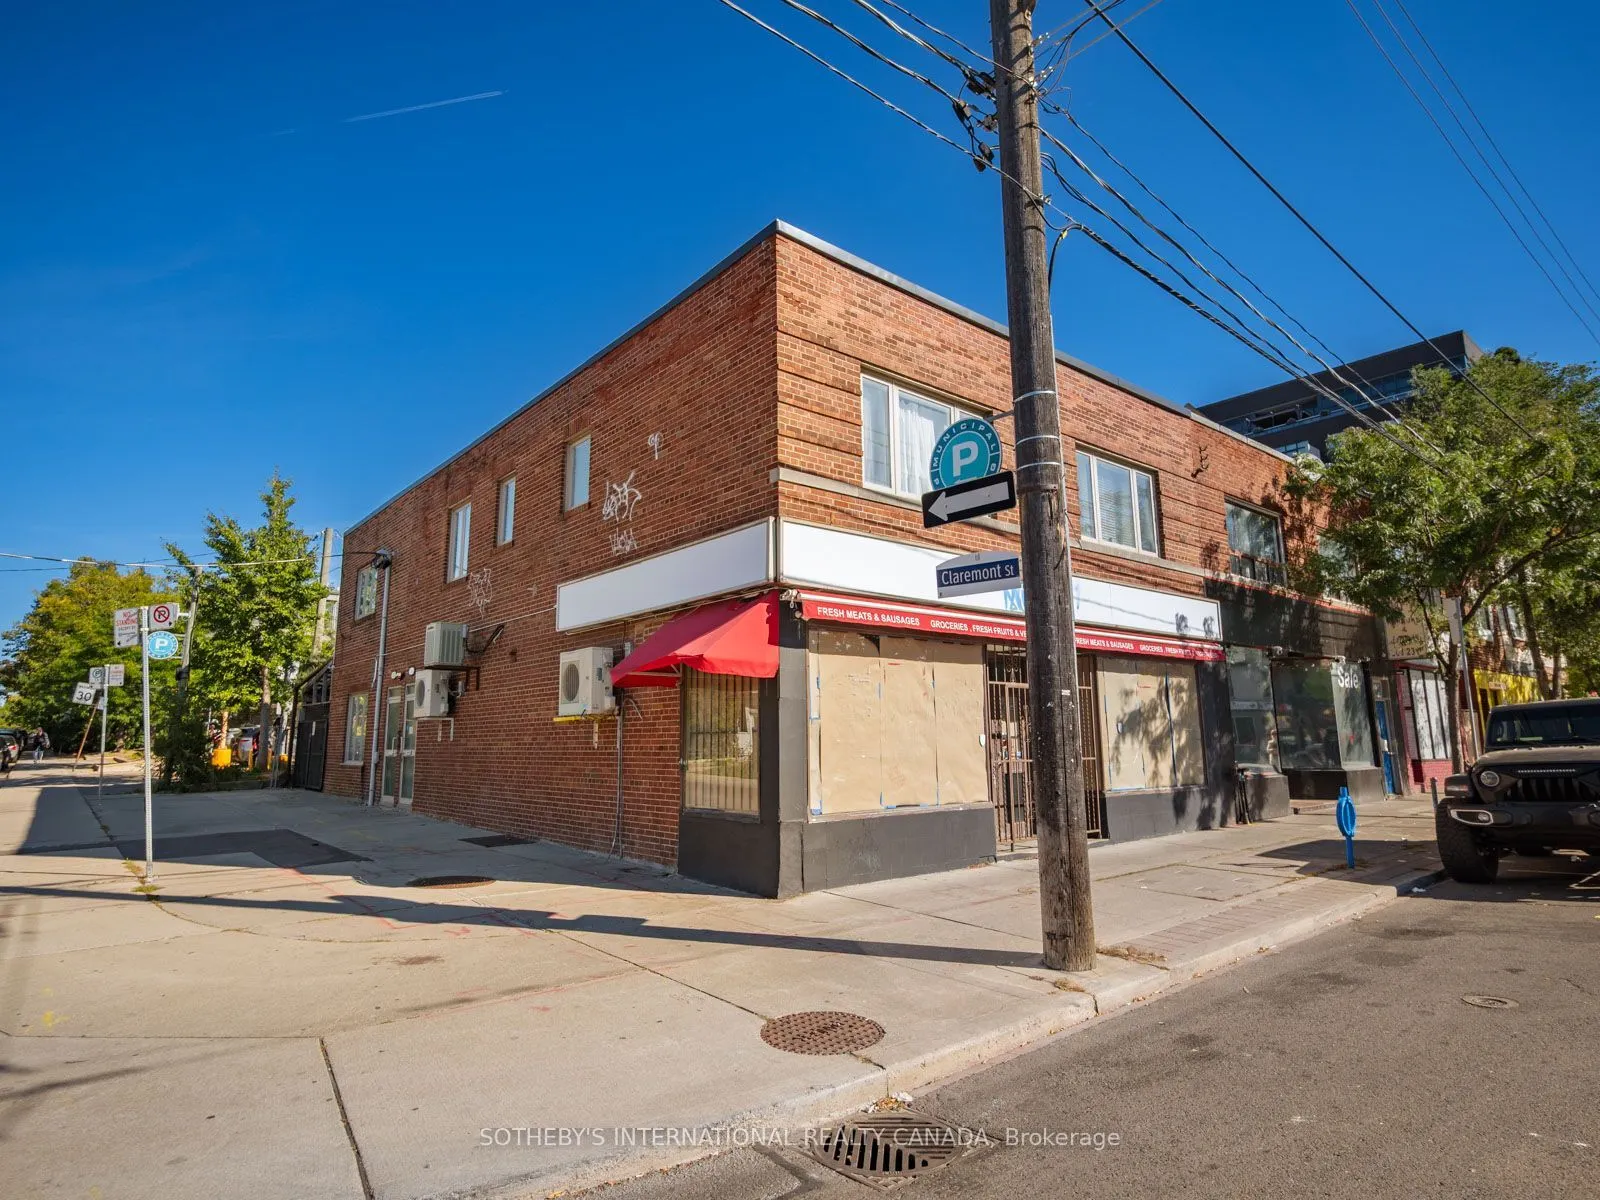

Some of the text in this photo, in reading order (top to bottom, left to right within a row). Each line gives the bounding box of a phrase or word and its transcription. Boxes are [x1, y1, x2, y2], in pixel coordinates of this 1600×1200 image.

[932, 422, 996, 467] MUNICIPAL
[952, 440, 979, 477] P
[941, 564, 1015, 585] Claremont St
[817, 606, 844, 618] FRESH
[846, 610, 872, 621] MEATS
[874, 613, 880, 621] &
[881, 614, 920, 626] SAUSAGES
[930, 619, 968, 631] GROCERIES
[973, 624, 993, 634] FRESH
[993, 627, 1013, 637] FRUITS
[1014, 629, 1019, 637] &
[1090, 638, 1105, 647] MEATS
[1110, 641, 1134, 650] SAUSAGES
[1139, 644, 1163, 653] GROCERIES
[155, 638, 169, 650] P
[1337, 666, 1359, 689] Sale
[76, 690, 92, 702] 30
